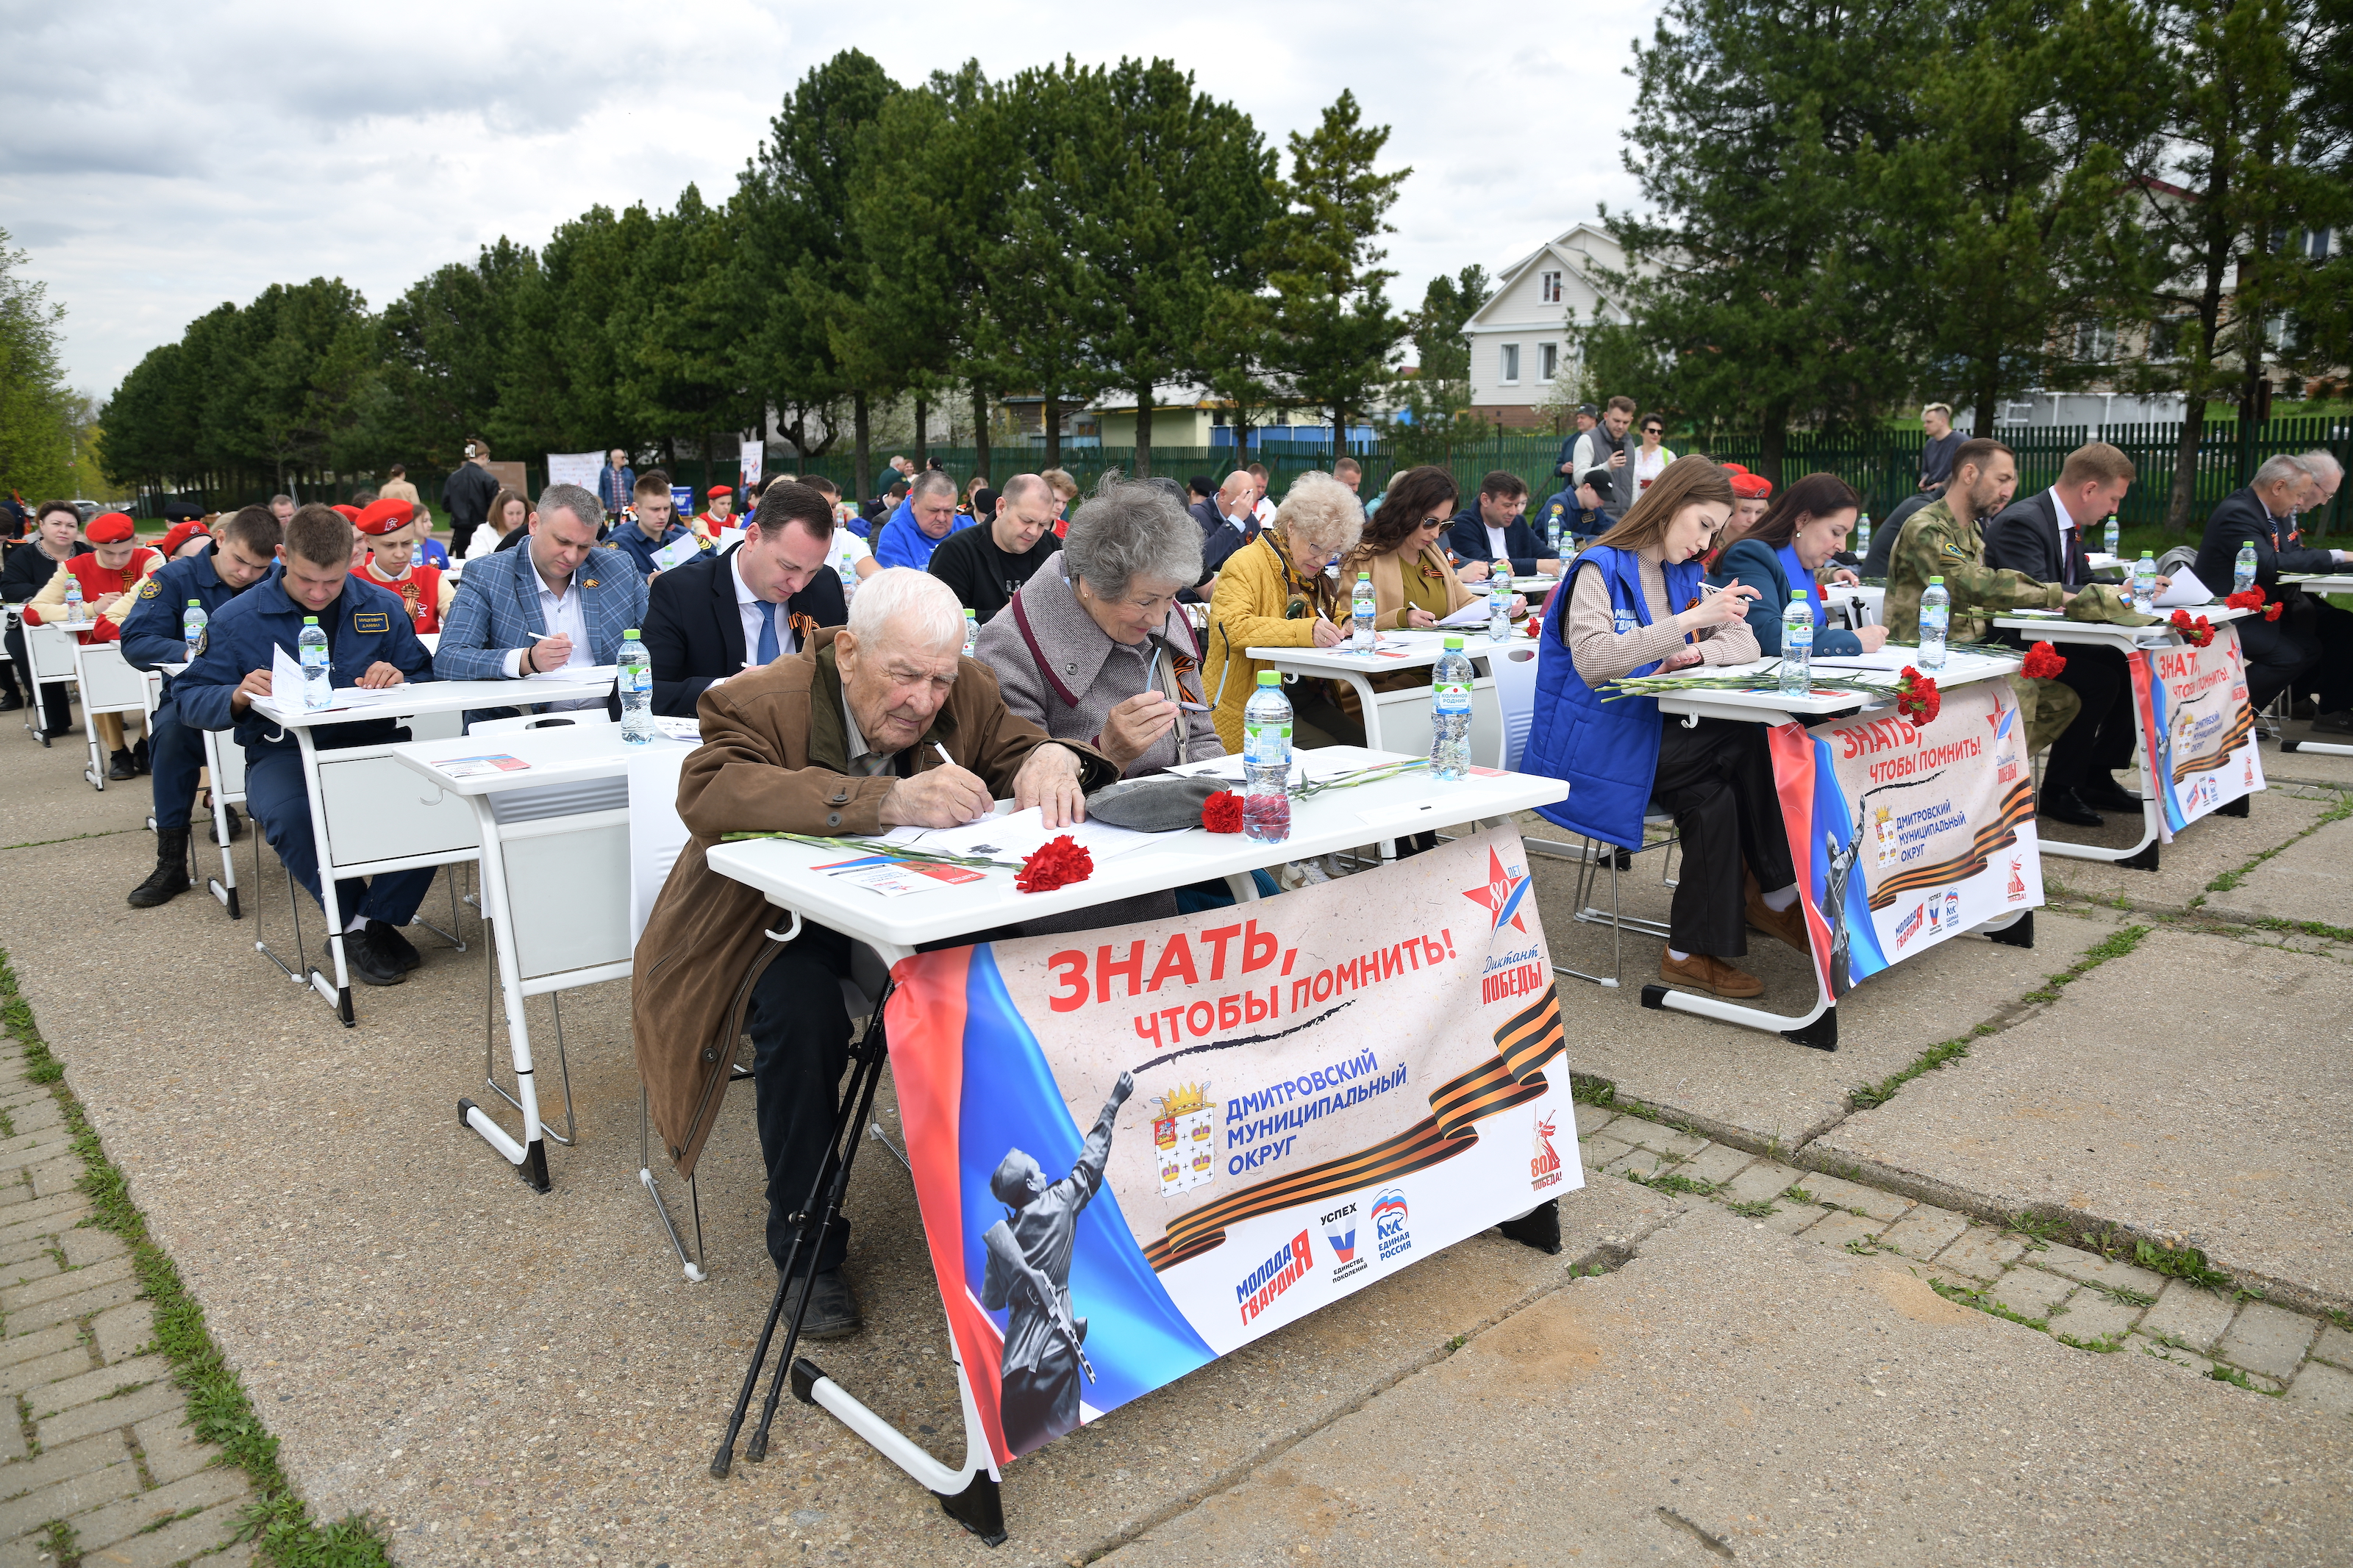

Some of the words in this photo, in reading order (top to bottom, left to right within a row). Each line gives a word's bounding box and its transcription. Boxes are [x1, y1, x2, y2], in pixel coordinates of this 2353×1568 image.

[1832, 716, 1922, 759] ЗНАТЬ,
[1869, 753, 1916, 784] ЧТОБЫ
[1919, 736, 1982, 771] ПОМНИТЬ!
[1896, 798, 1951, 832] ДМИТРОВСКИЙ
[1899, 810, 1967, 846] МУНИЦИПАЛЬНЫЙ
[1901, 843, 1925, 862] ОКРУГ
[1507, 864, 1521, 878] ЛЕТ
[1489, 878, 1512, 911] 80
[1048, 918, 1299, 1013] ЗНАТЬ,
[1482, 944, 1539, 975] Диктант
[1134, 985, 1279, 1048] ЧТОБЫ
[1291, 928, 1457, 1013] ПОМНИТЬ!
[1482, 962, 1543, 1006] ПОБЕДЫ
[1226, 1048, 1379, 1125] ДМИТРОВСКИЙ
[1227, 1062, 1407, 1150] МУНИЦИПАЛЬНЫЙ
[1228, 1135, 1297, 1175] ОКРУГ
[1530, 1155, 1548, 1178] 80
[1320, 1202, 1357, 1226] УСПЕХ
[1378, 1231, 1410, 1252] ЕДИНАЯ
[1379, 1241, 1412, 1261] РОССИЯ
[1332, 1262, 1368, 1284] ПОКОЛЕНИЙ
[1333, 1257, 1364, 1275] ЕДИНСТВЕ
